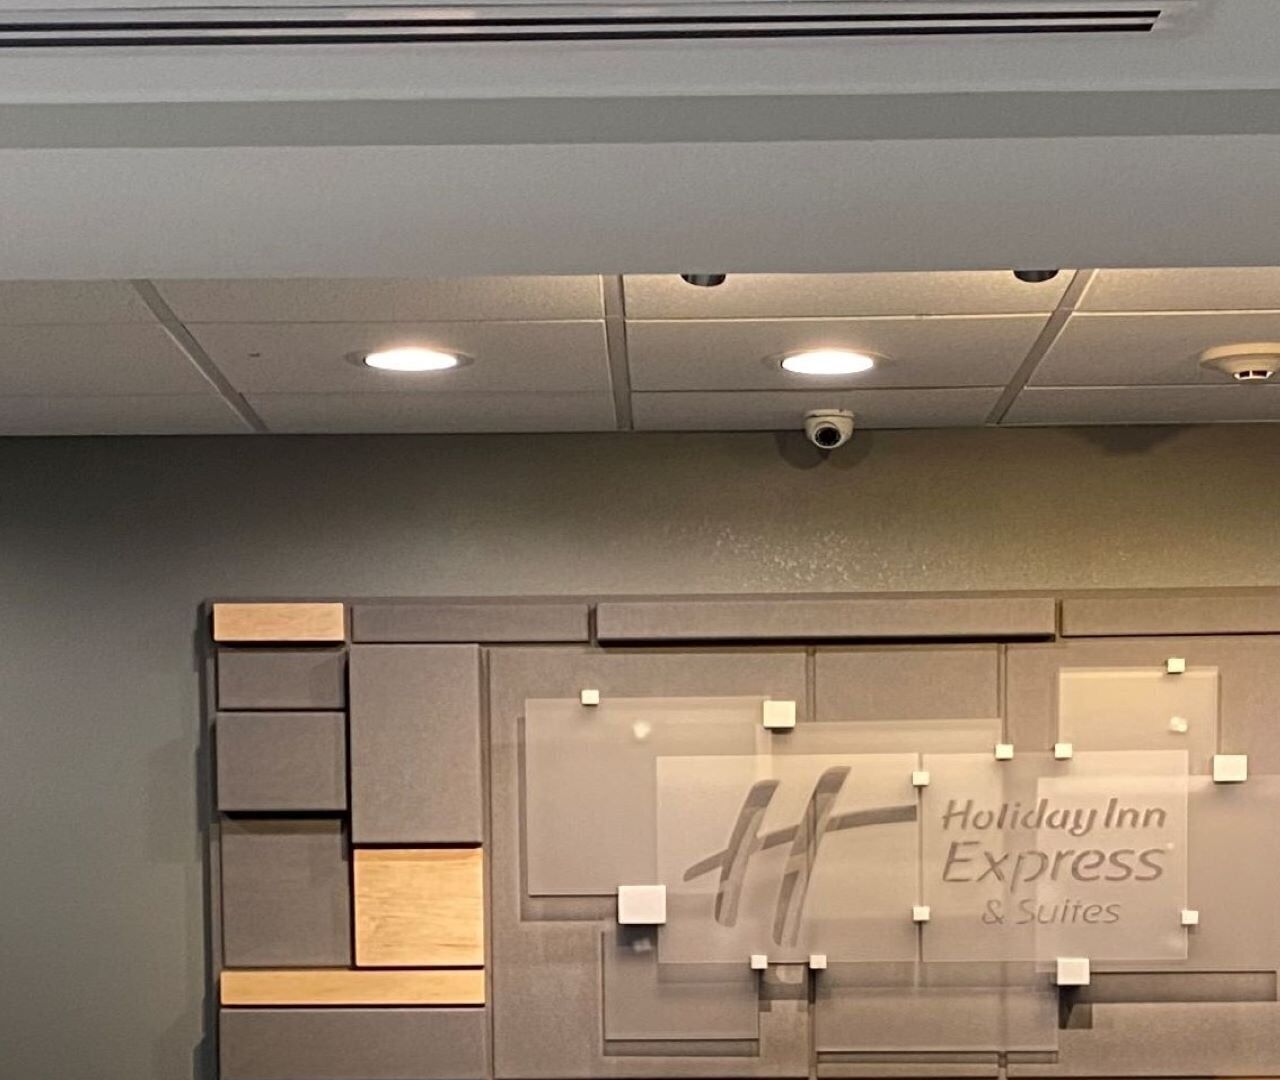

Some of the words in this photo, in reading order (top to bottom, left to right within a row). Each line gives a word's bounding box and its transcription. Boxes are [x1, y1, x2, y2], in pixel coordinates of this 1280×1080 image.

[942, 798, 1097, 837] Holiday
[1104, 798, 1167, 829] Inn
[942, 841, 1166, 893] Express
[981, 899, 1005, 925] &
[1016, 899, 1121, 925] Suites
